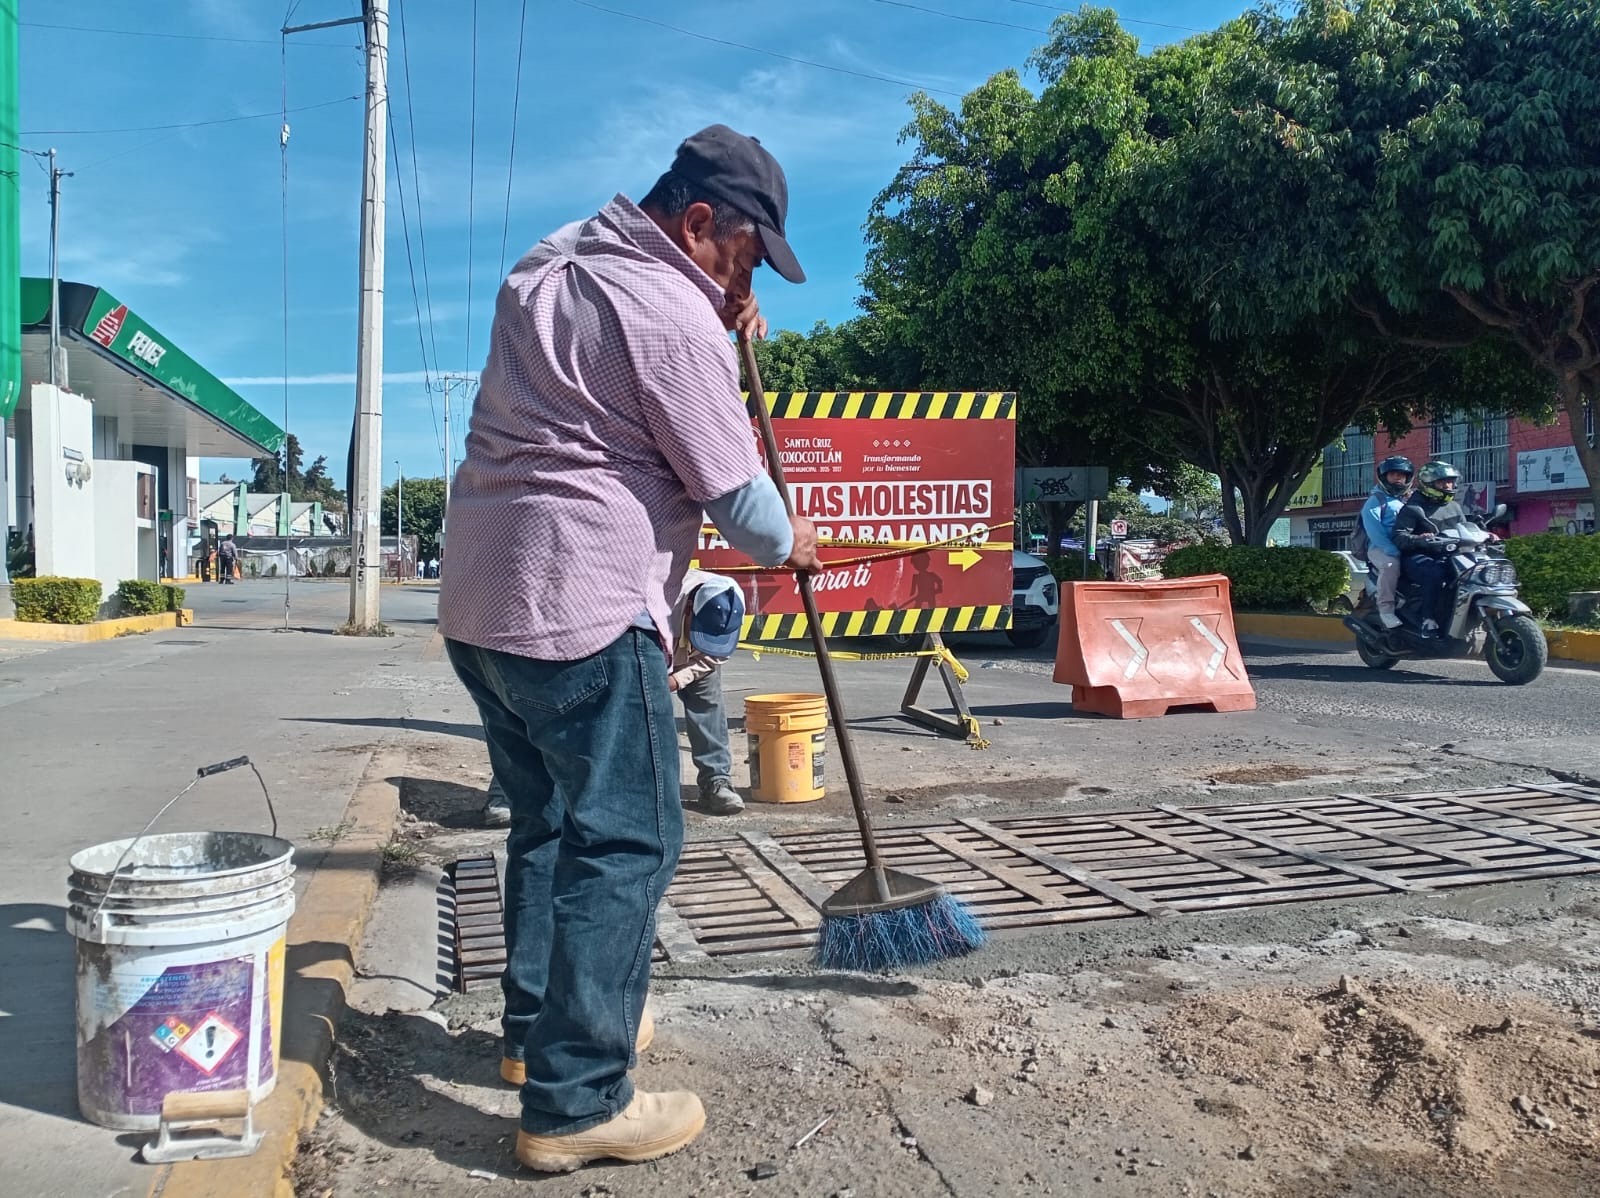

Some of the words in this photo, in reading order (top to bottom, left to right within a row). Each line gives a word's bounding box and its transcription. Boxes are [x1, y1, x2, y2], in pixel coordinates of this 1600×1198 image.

[127, 329, 167, 369] PEMEX
[784, 437, 811, 449] SANTA
[812, 437, 832, 448] CRUZ
[862, 465, 875, 474] por
[885, 464, 921, 472] bienestar
[863, 454, 922, 463] Transformando
[795, 485, 843, 518] LAS
[849, 483, 989, 517] MOLESTIAS
[816, 522, 990, 548] RABAJANDO
[854, 561, 872, 587] ti
